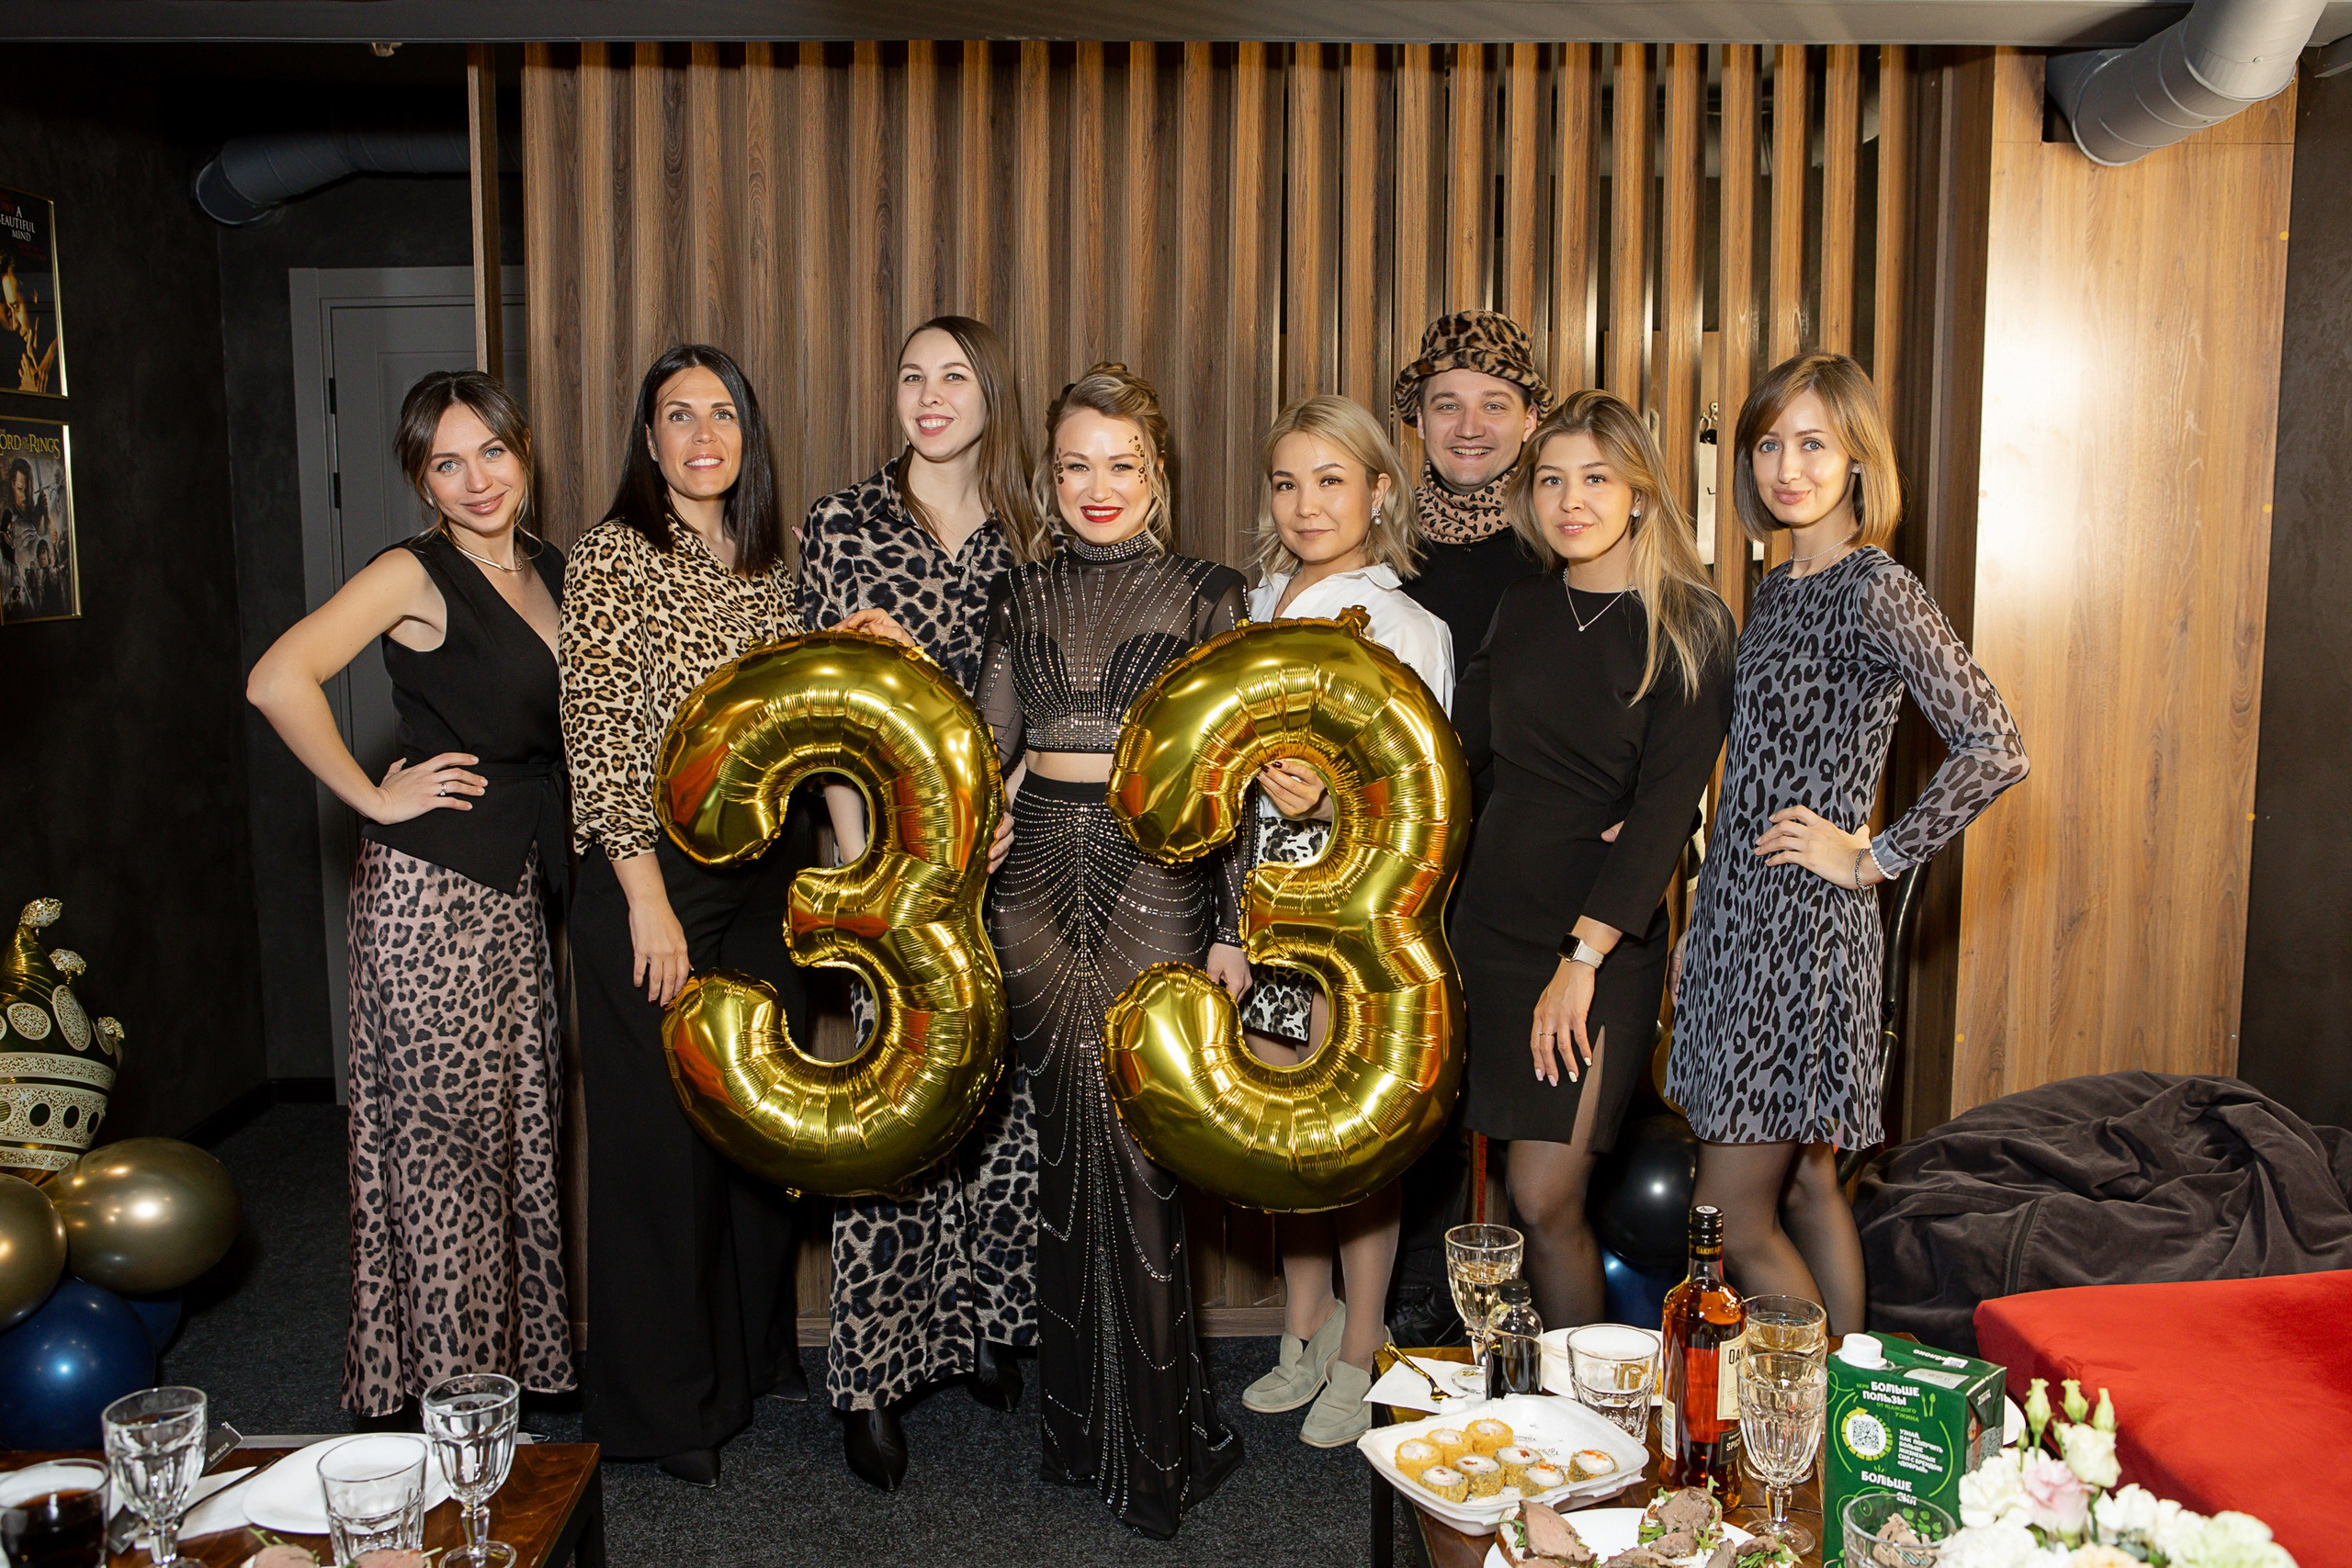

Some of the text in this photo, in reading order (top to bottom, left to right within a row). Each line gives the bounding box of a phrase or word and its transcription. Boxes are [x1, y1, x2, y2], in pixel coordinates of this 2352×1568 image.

[16, 205, 23, 218] A
[0, 213, 36, 233] EAUTIFUL
[12, 229, 31, 242] MIND
[0, 434, 21, 451] ORD
[28, 434, 61, 460] RINGS
[1871, 1381, 1920, 1397] БОЛЬШЕ
[1862, 1390, 1907, 1406] ПОЛЬЗЫ
[1884, 1403, 1917, 1415] КАЖДОГО
[1894, 1411, 1919, 1423] УЖИНА
[1898, 1440, 1924, 1453] БОЛЬШЕ
[1899, 1434, 1944, 1454] КАК ПОЛУЧИТЬ
[1897, 1452, 1911, 1462] СИЛ
[1915, 1458, 1943, 1472] БРЕНДОМ
[1860, 1470, 1913, 1493] БОЛЬШЕ
[1895, 1491, 1917, 1506] СИЛ
